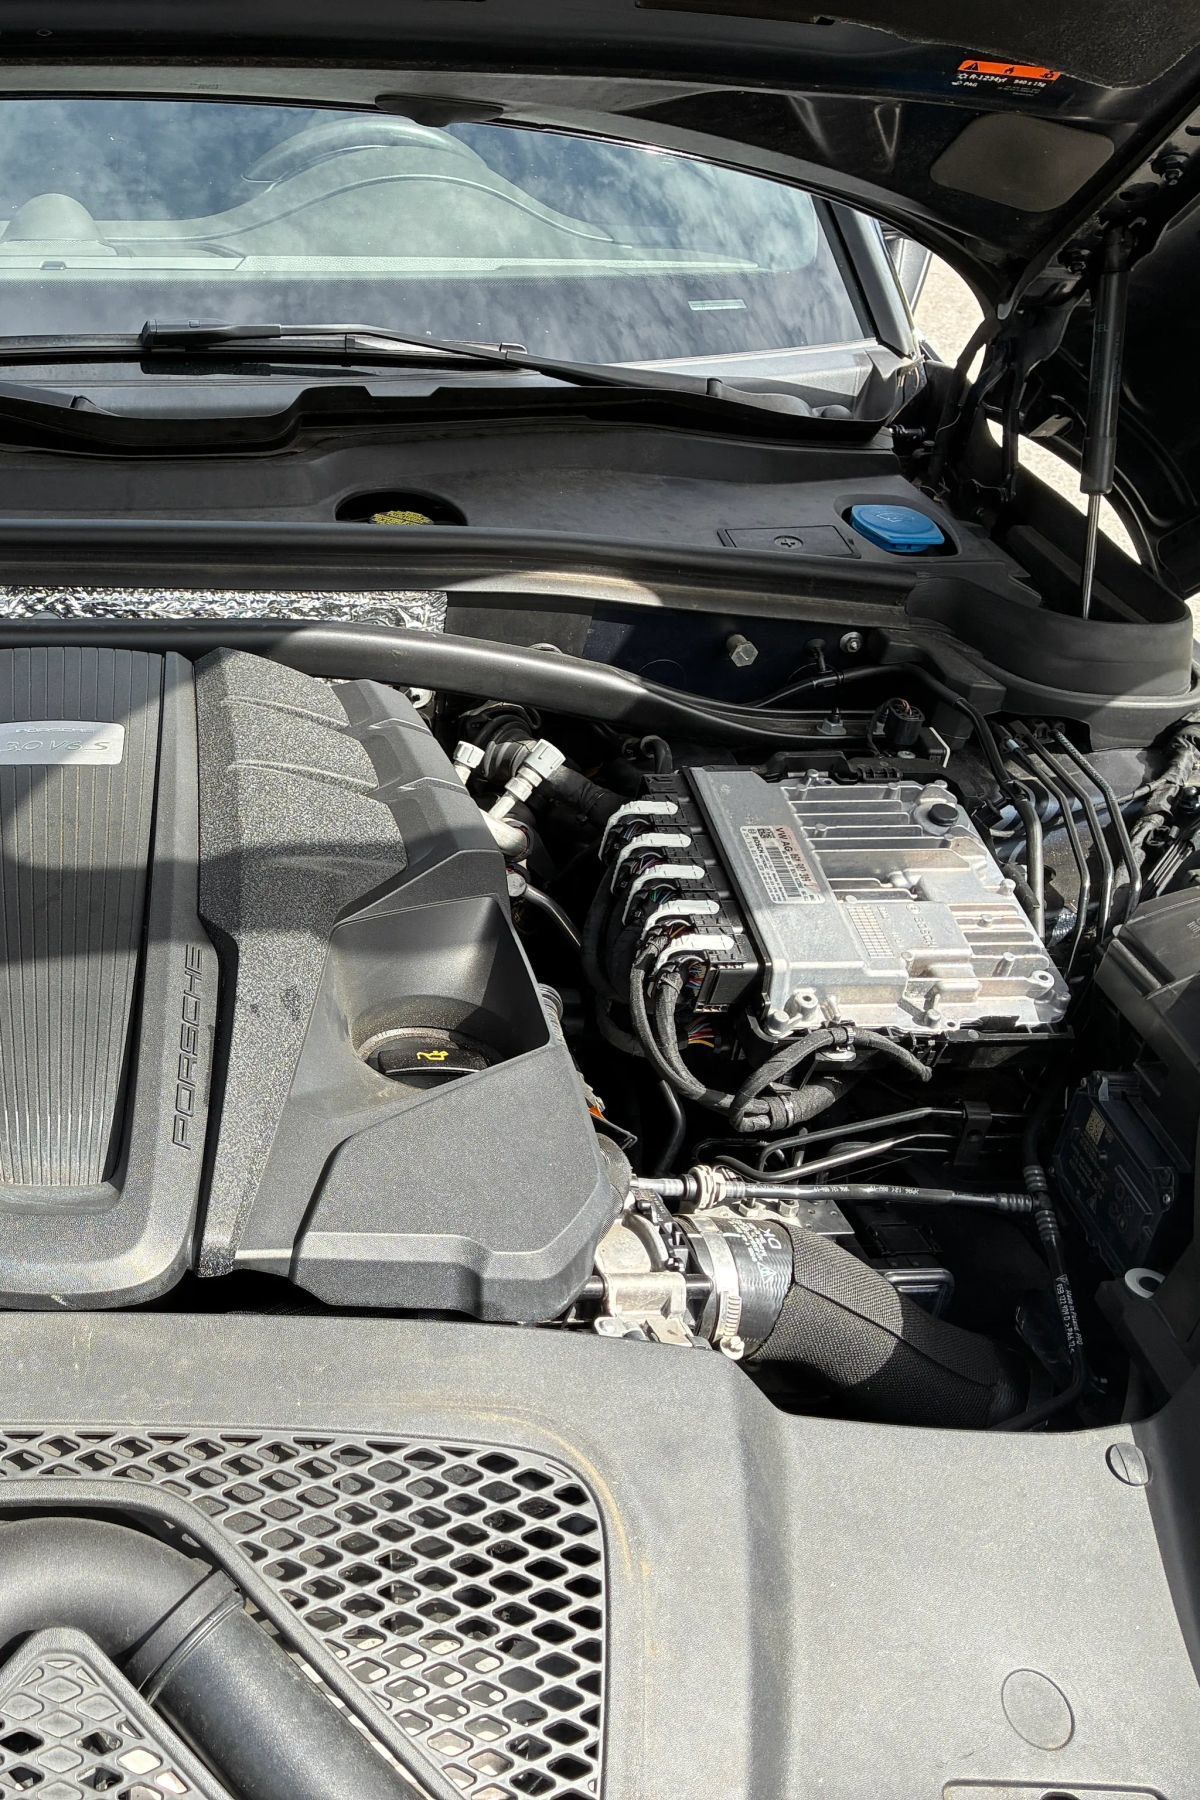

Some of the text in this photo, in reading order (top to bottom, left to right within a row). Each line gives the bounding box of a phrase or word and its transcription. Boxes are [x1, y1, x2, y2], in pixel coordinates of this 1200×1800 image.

[969, 74, 1007, 83] R-1234yf
[752, 835, 765, 854] BOSCH
[776, 827, 788, 839] VW
[782, 840, 794, 853] AG
[172, 943, 203, 1150] PORSCHE
